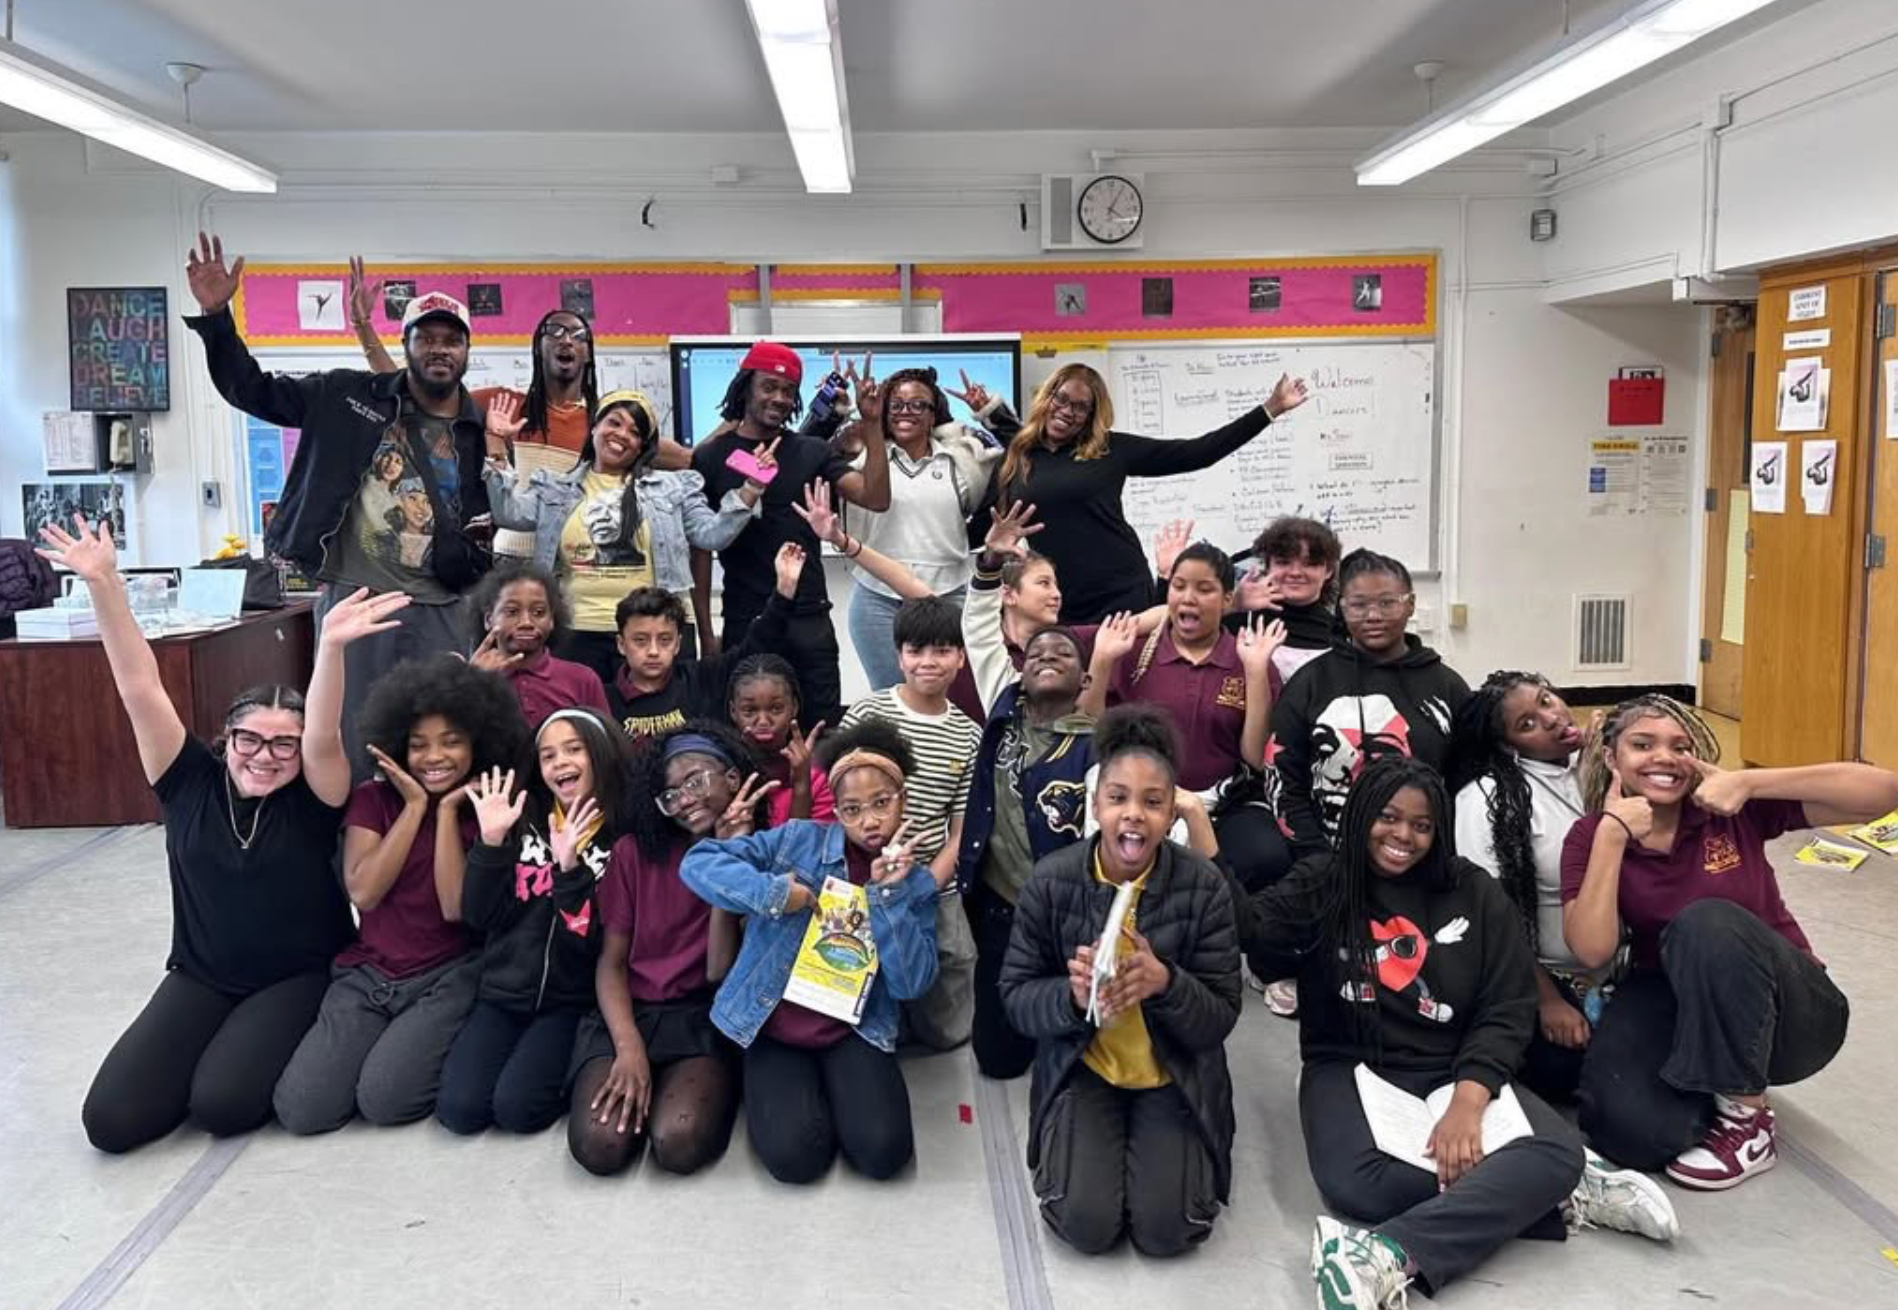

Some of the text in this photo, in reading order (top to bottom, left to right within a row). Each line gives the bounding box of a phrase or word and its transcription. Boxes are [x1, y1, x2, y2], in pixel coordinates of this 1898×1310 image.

[73, 293, 164, 317] DANCE
[73, 317, 165, 341] LAUGH
[73, 340, 166, 364] CREATE
[74, 362, 167, 387] DREAM
[74, 385, 168, 407] BELIEVE
[623, 709, 686, 736] SPIDERMAN
